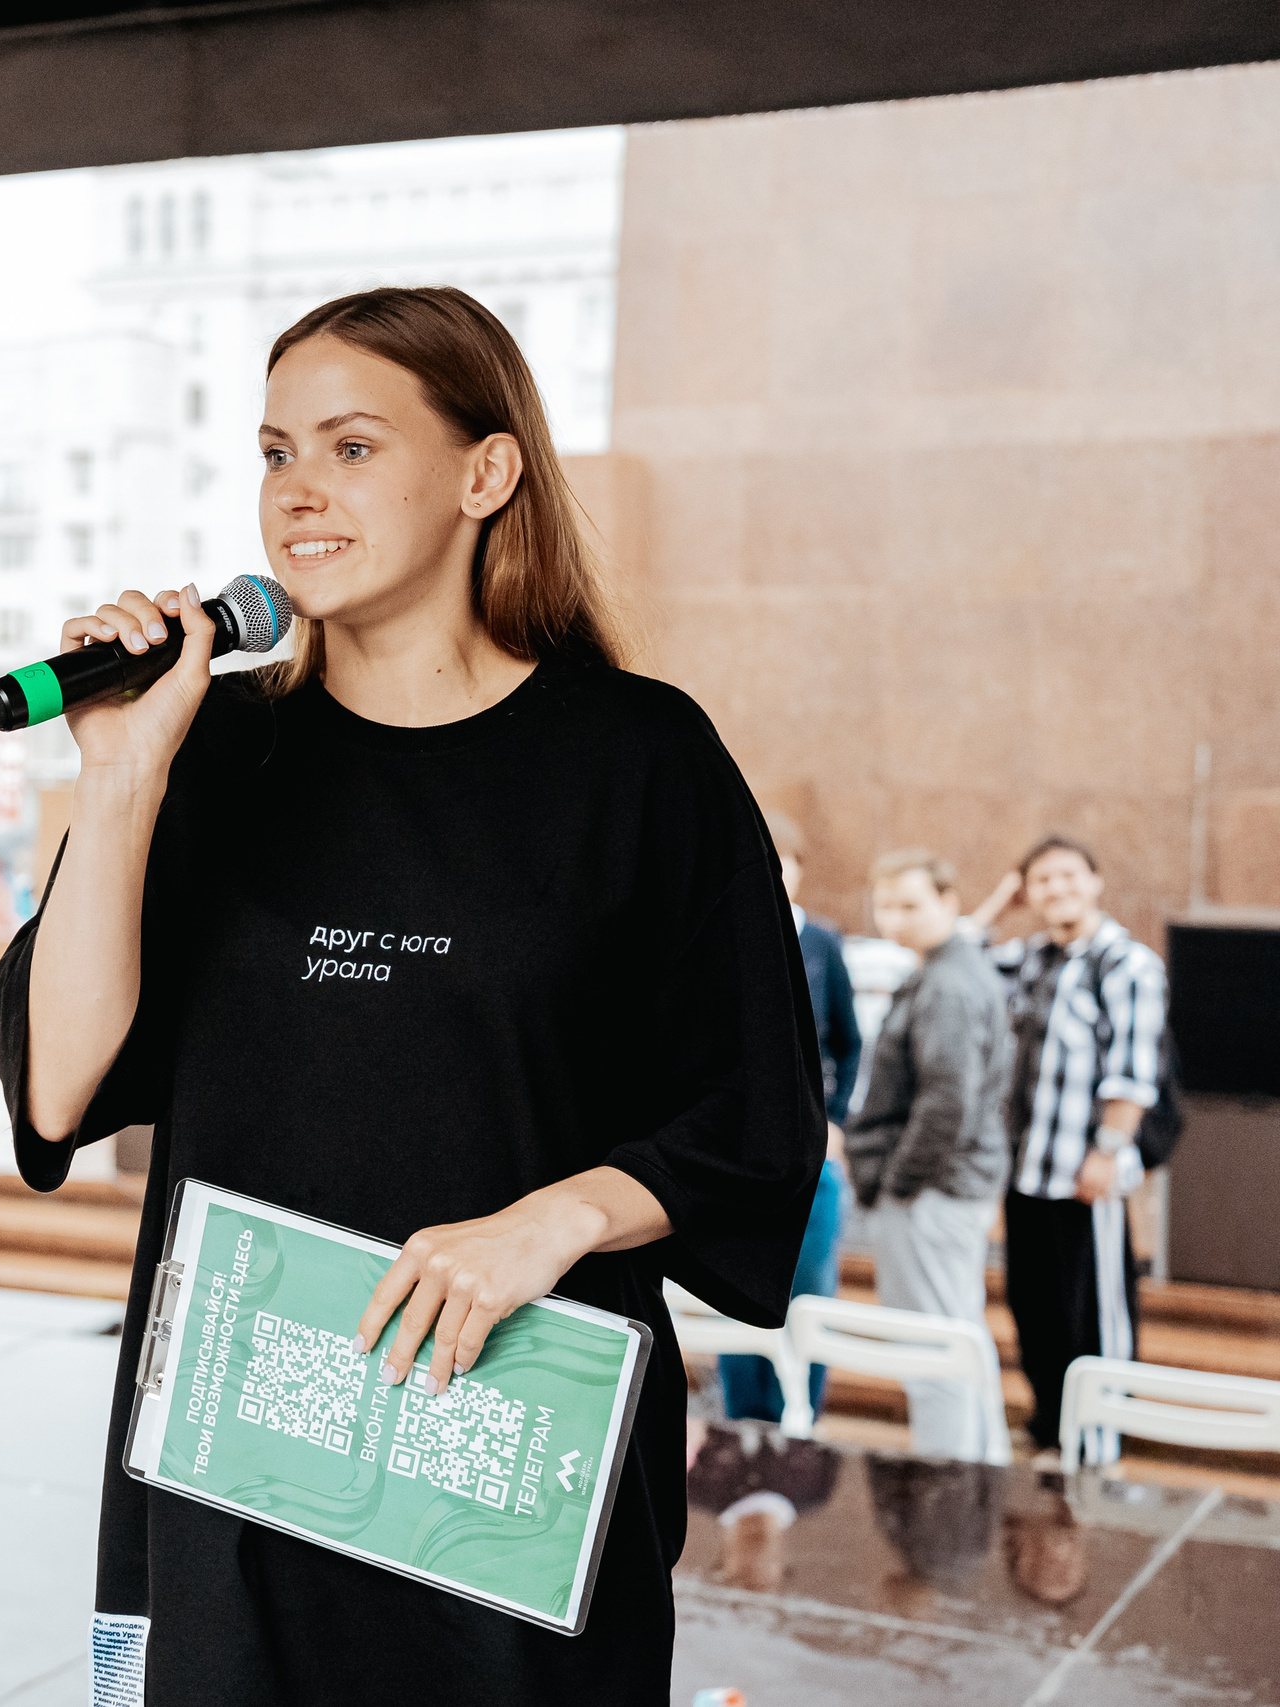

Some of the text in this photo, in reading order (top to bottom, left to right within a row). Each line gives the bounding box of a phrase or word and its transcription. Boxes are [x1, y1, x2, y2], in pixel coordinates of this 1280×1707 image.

[217, 606, 233, 633] SHURE
[301, 955, 392, 983] урала
[309, 925, 452, 954] друг с юга
[185, 1271, 227, 1424] ПОДПИСЫВАЙСЯ!
[193, 1229, 253, 1475] ТВОИ ВОЗМОЖНОСТИ ЗДЕСЬ
[514, 1405, 555, 1516] ТЕЛЕГРАМ
